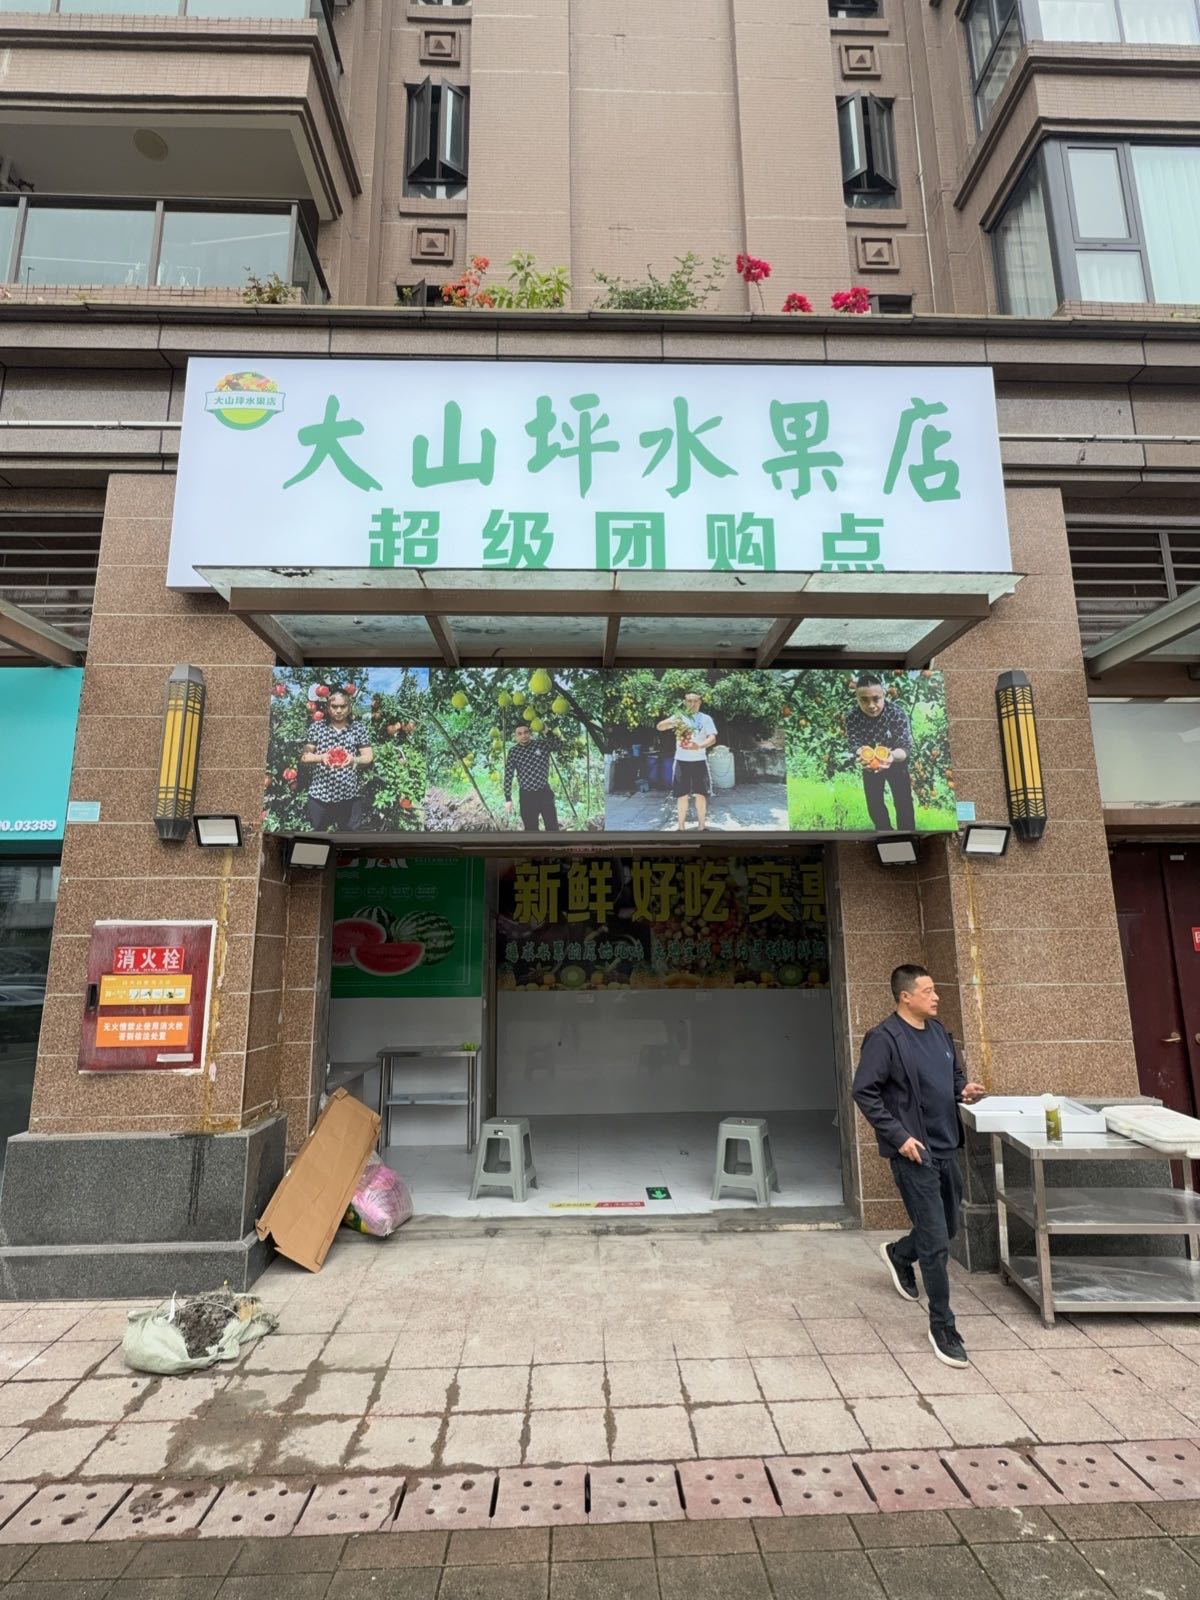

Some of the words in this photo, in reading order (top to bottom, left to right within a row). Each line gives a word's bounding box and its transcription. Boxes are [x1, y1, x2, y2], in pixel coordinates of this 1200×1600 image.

[283, 394, 960, 502] 大山坪水果店
[368, 507, 885, 571] 超级团购点
[0, 820, 57, 832] 0.03389
[513, 861, 614, 923] 新鲜
[632, 860, 730, 923] 好吃
[117, 948, 181, 969] 消火栓
